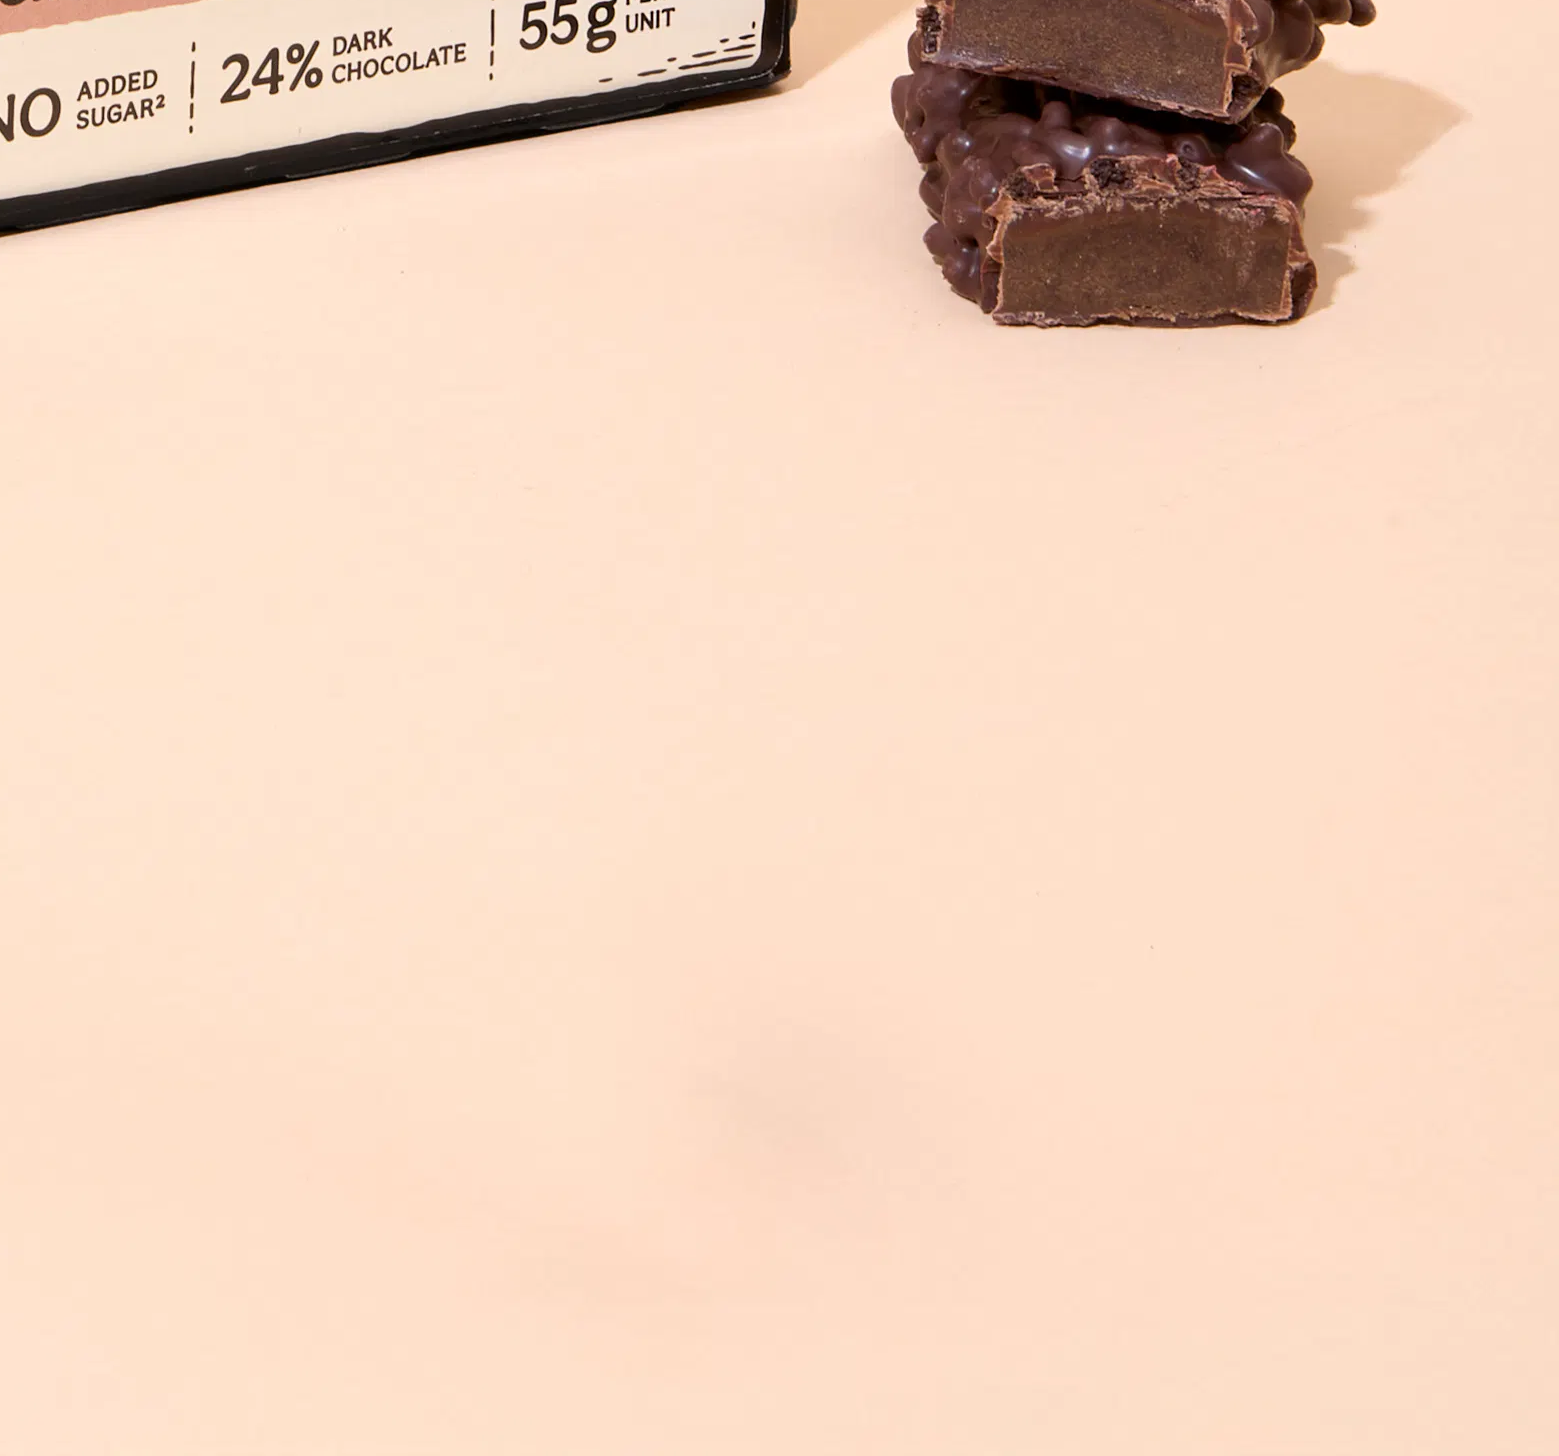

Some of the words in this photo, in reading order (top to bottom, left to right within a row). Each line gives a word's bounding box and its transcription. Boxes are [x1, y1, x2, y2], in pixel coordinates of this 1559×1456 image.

[625, 7, 676, 33] UNIT
[219, 40, 324, 104] 24%
[332, 25, 394, 56] DARK
[331, 42, 467, 85] CHOCOLATE
[76, 68, 159, 101] ADDED
[75, 95, 167, 130] SUGAR²
